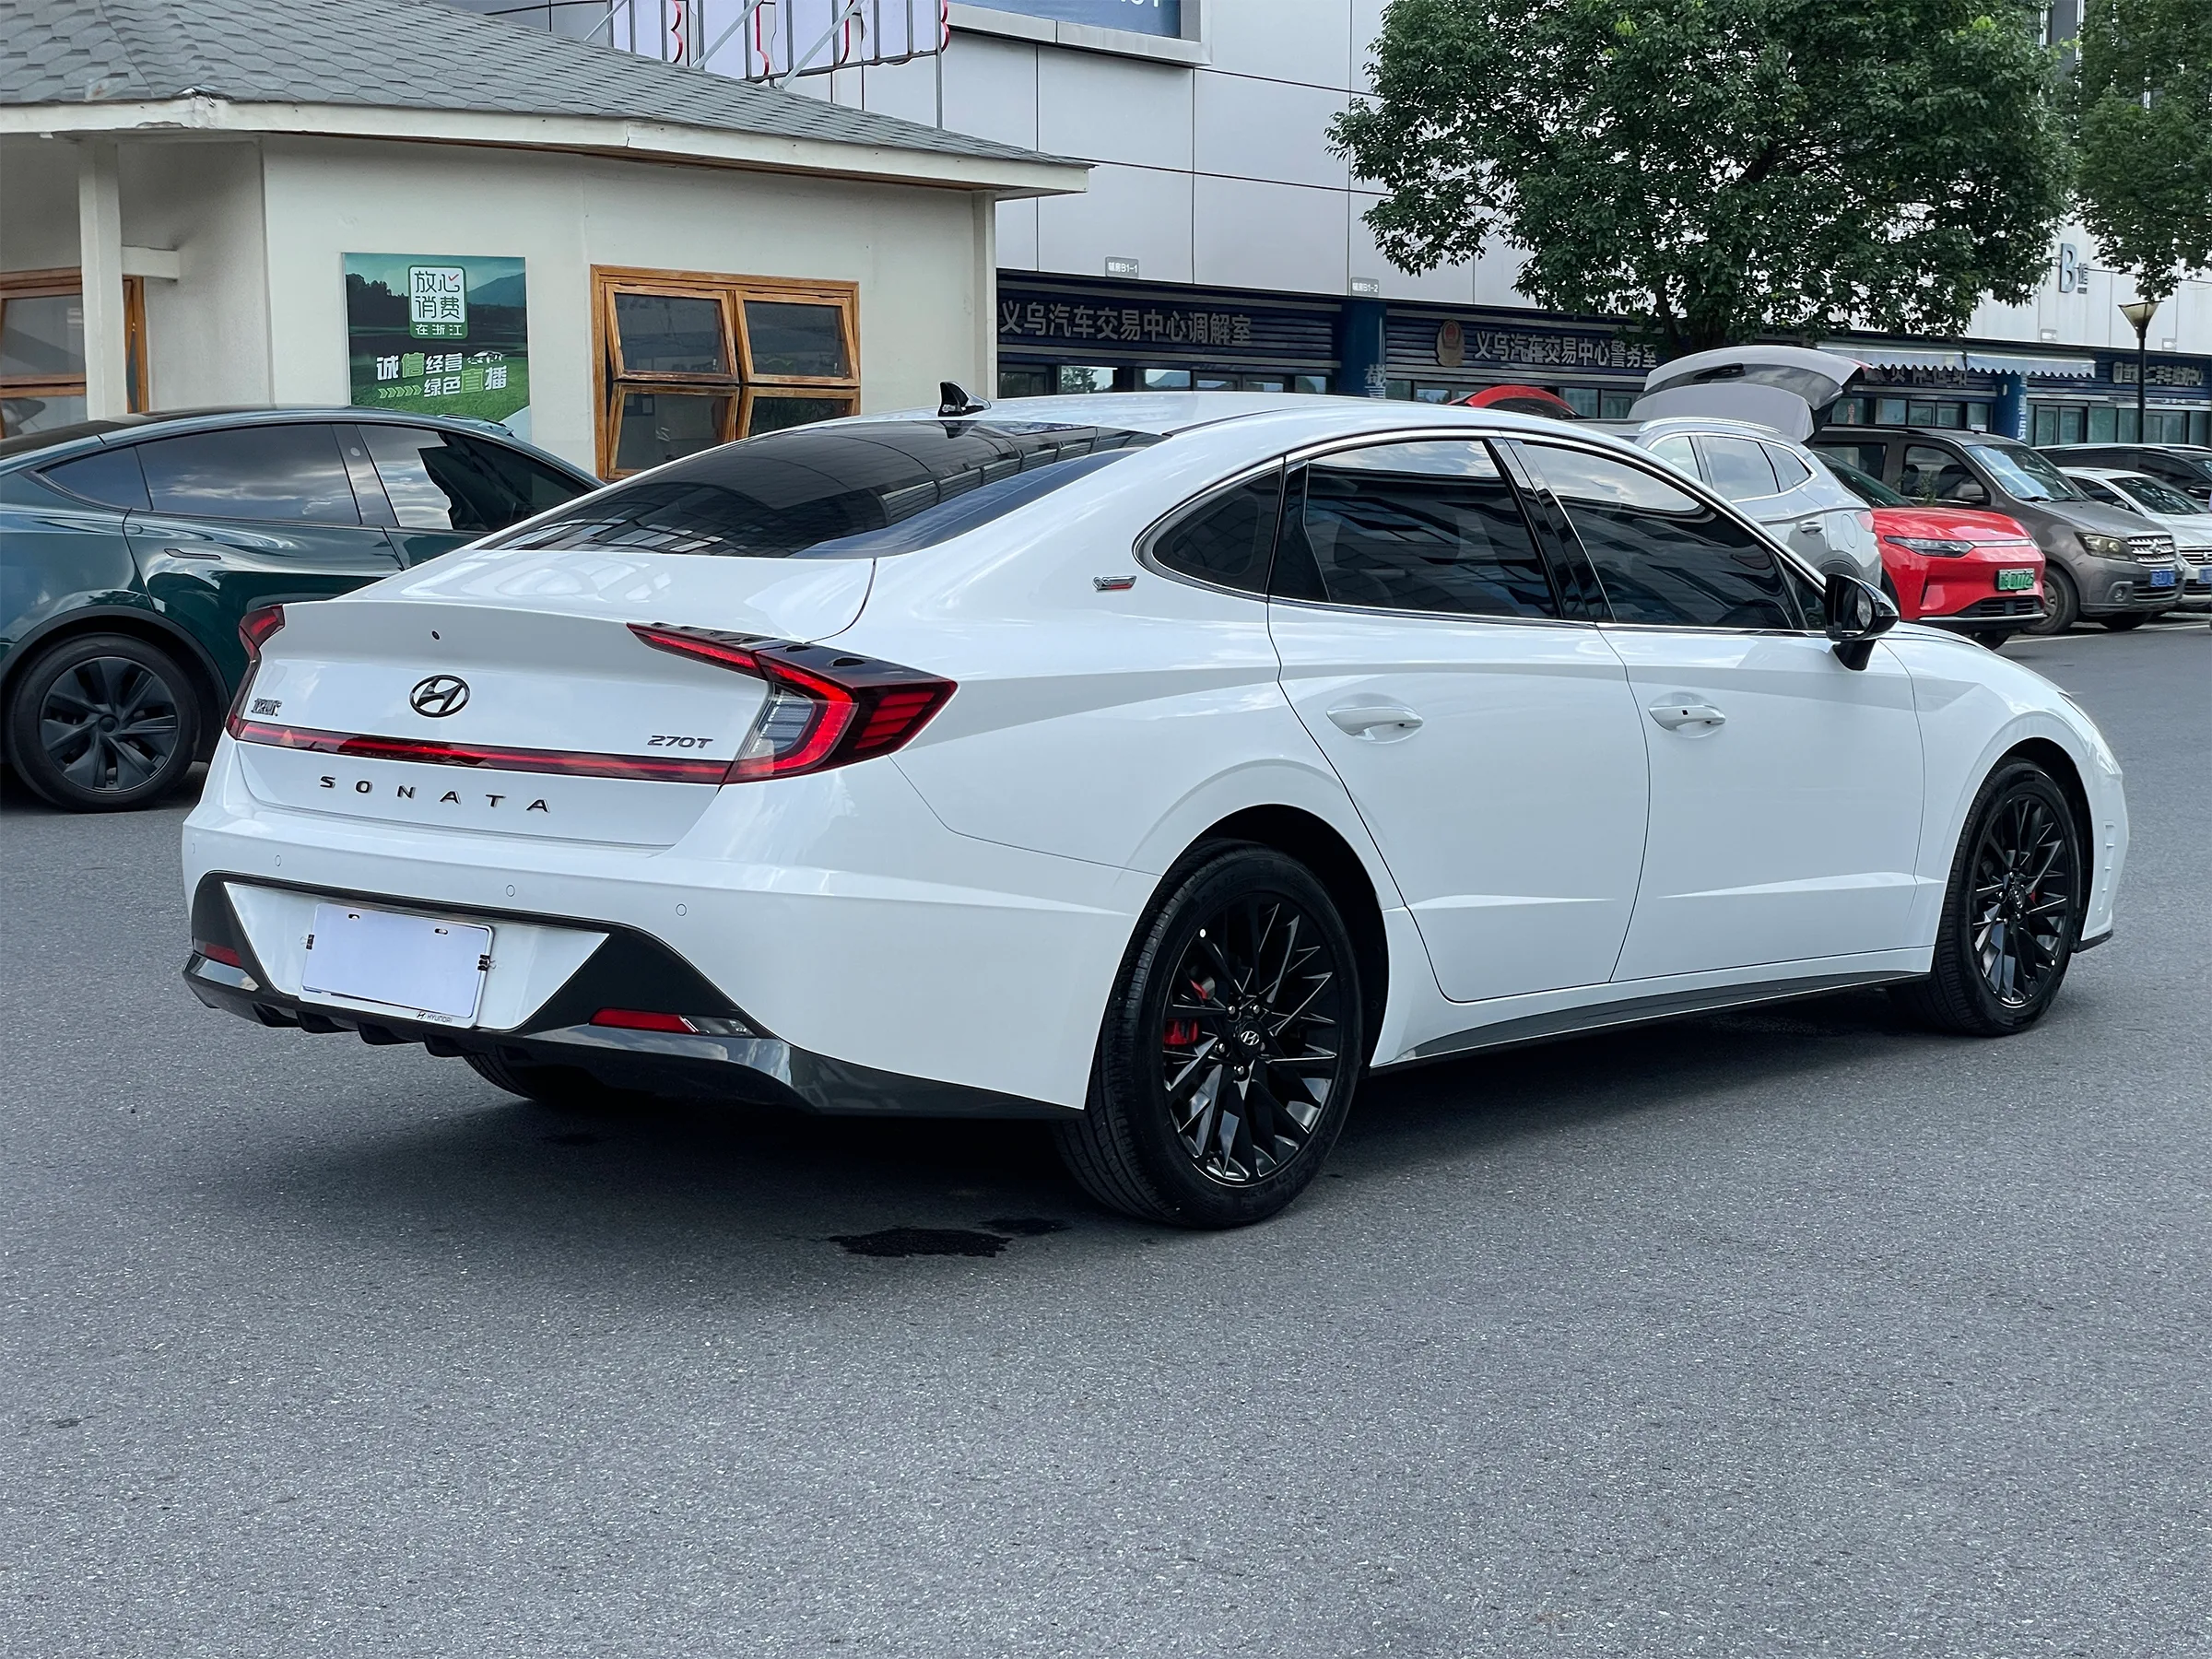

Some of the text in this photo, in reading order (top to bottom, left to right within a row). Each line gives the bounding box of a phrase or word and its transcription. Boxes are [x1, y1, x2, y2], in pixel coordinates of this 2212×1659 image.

[414, 271, 460, 293] 放心
[1352, 282, 1379, 293] B1-2
[415, 296, 460, 319] 消费
[415, 324, 463, 335] 在浙江
[999, 300, 1253, 346] 义乌汽车交易中心调解室
[376, 352, 463, 381] 诚信经营
[424, 365, 508, 397] 绿色直播
[647, 735, 713, 749] 270T
[320, 775, 551, 814] SONATA
[427, 1014, 453, 1024] HYUNDAI
